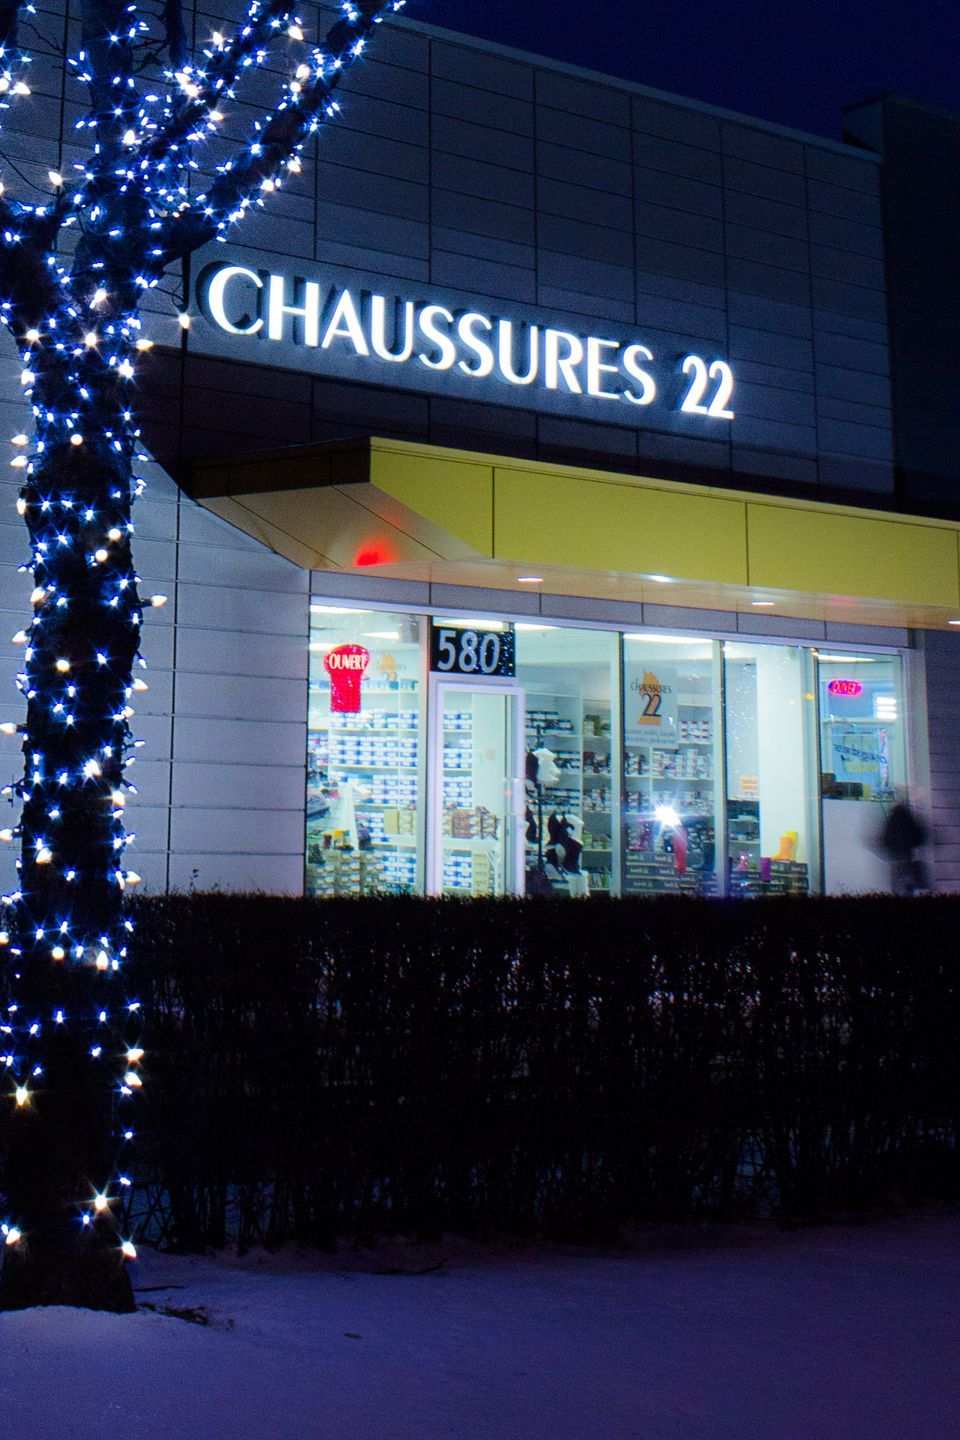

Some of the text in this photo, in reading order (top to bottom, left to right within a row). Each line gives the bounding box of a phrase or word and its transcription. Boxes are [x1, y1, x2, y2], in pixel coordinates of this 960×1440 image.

[208, 265, 734, 419] CHAUSSURES 22
[328, 653, 367, 670] OUVERT
[437, 629, 502, 674] 580
[642, 693, 662, 717] 22
